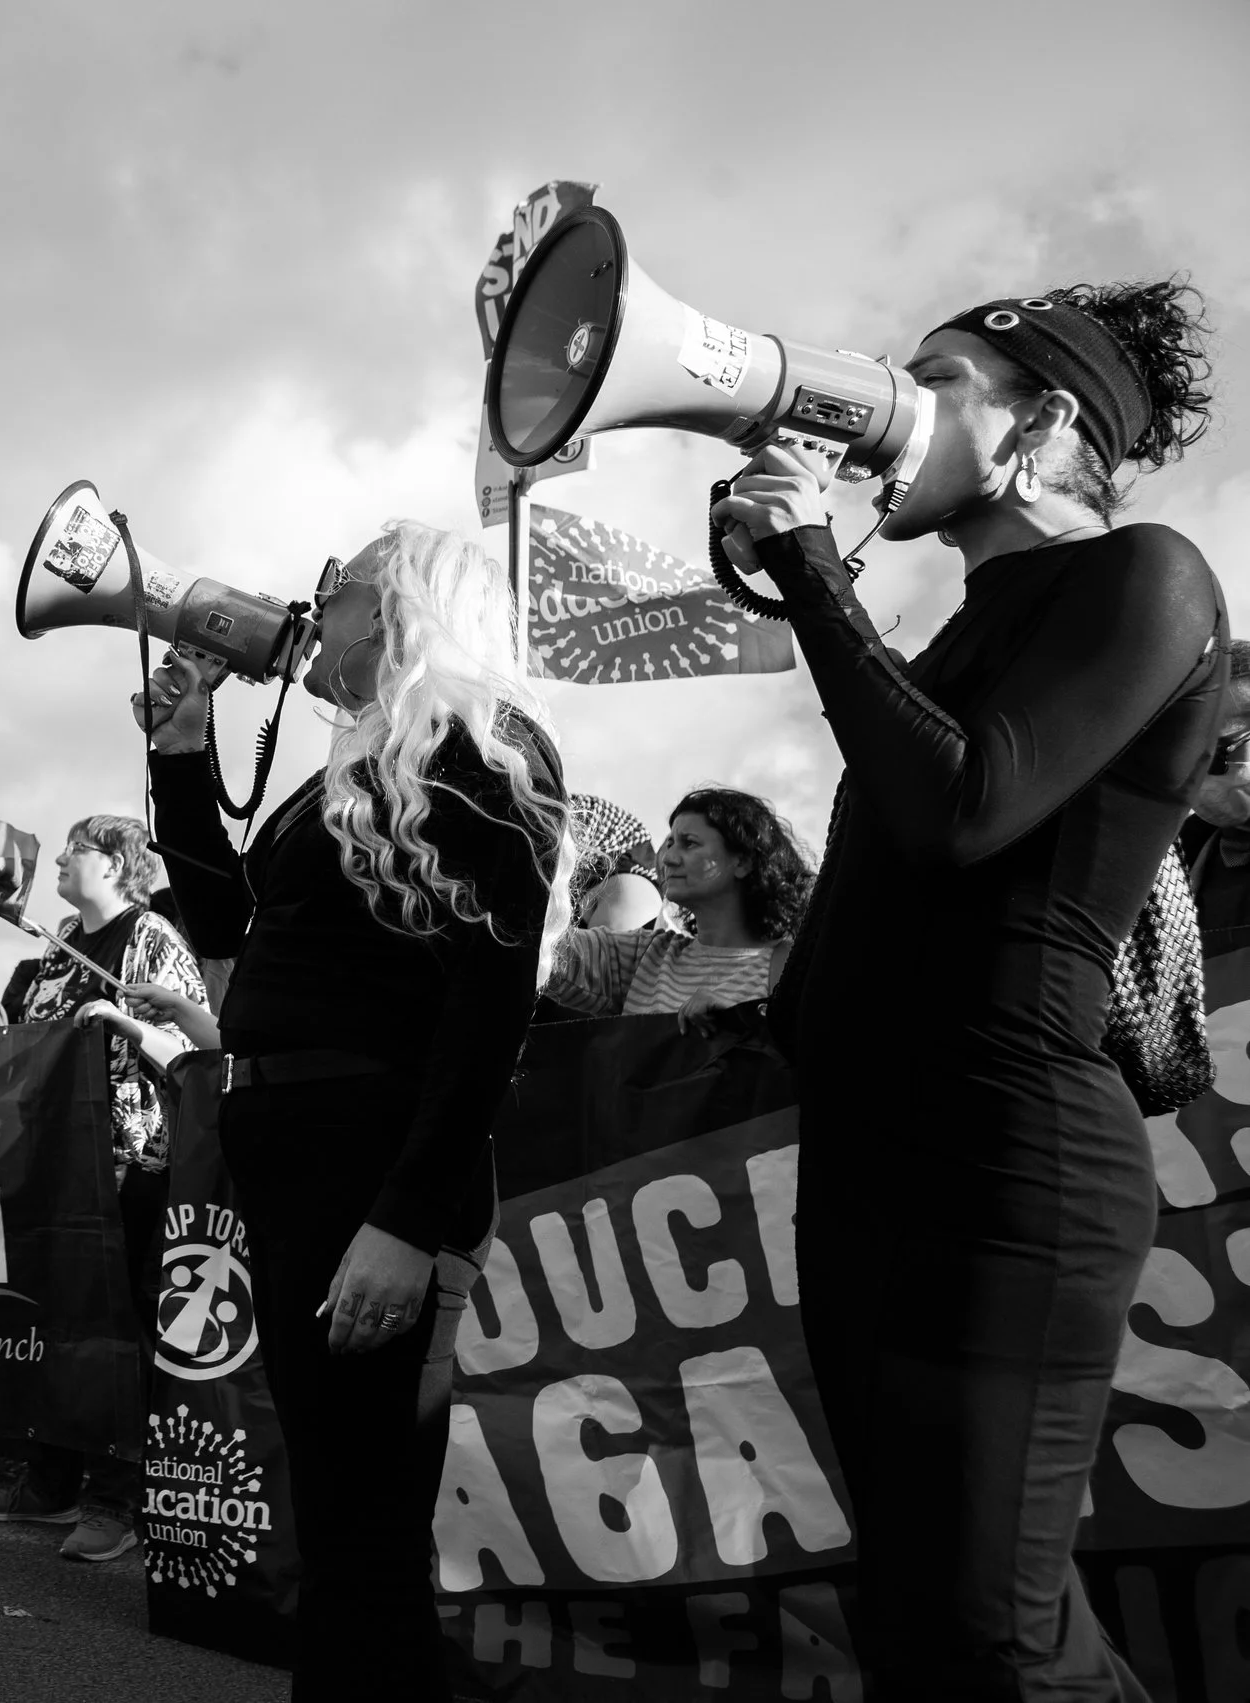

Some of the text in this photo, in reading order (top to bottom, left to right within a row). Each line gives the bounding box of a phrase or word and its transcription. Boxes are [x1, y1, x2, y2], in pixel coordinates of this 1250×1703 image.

[76, 549, 94, 569] TO
[591, 606, 688, 645] union
[165, 1204, 196, 1240] UP
[205, 1203, 234, 1241] TO
[147, 1522, 208, 1549] union
[437, 1601, 636, 1679] HE
